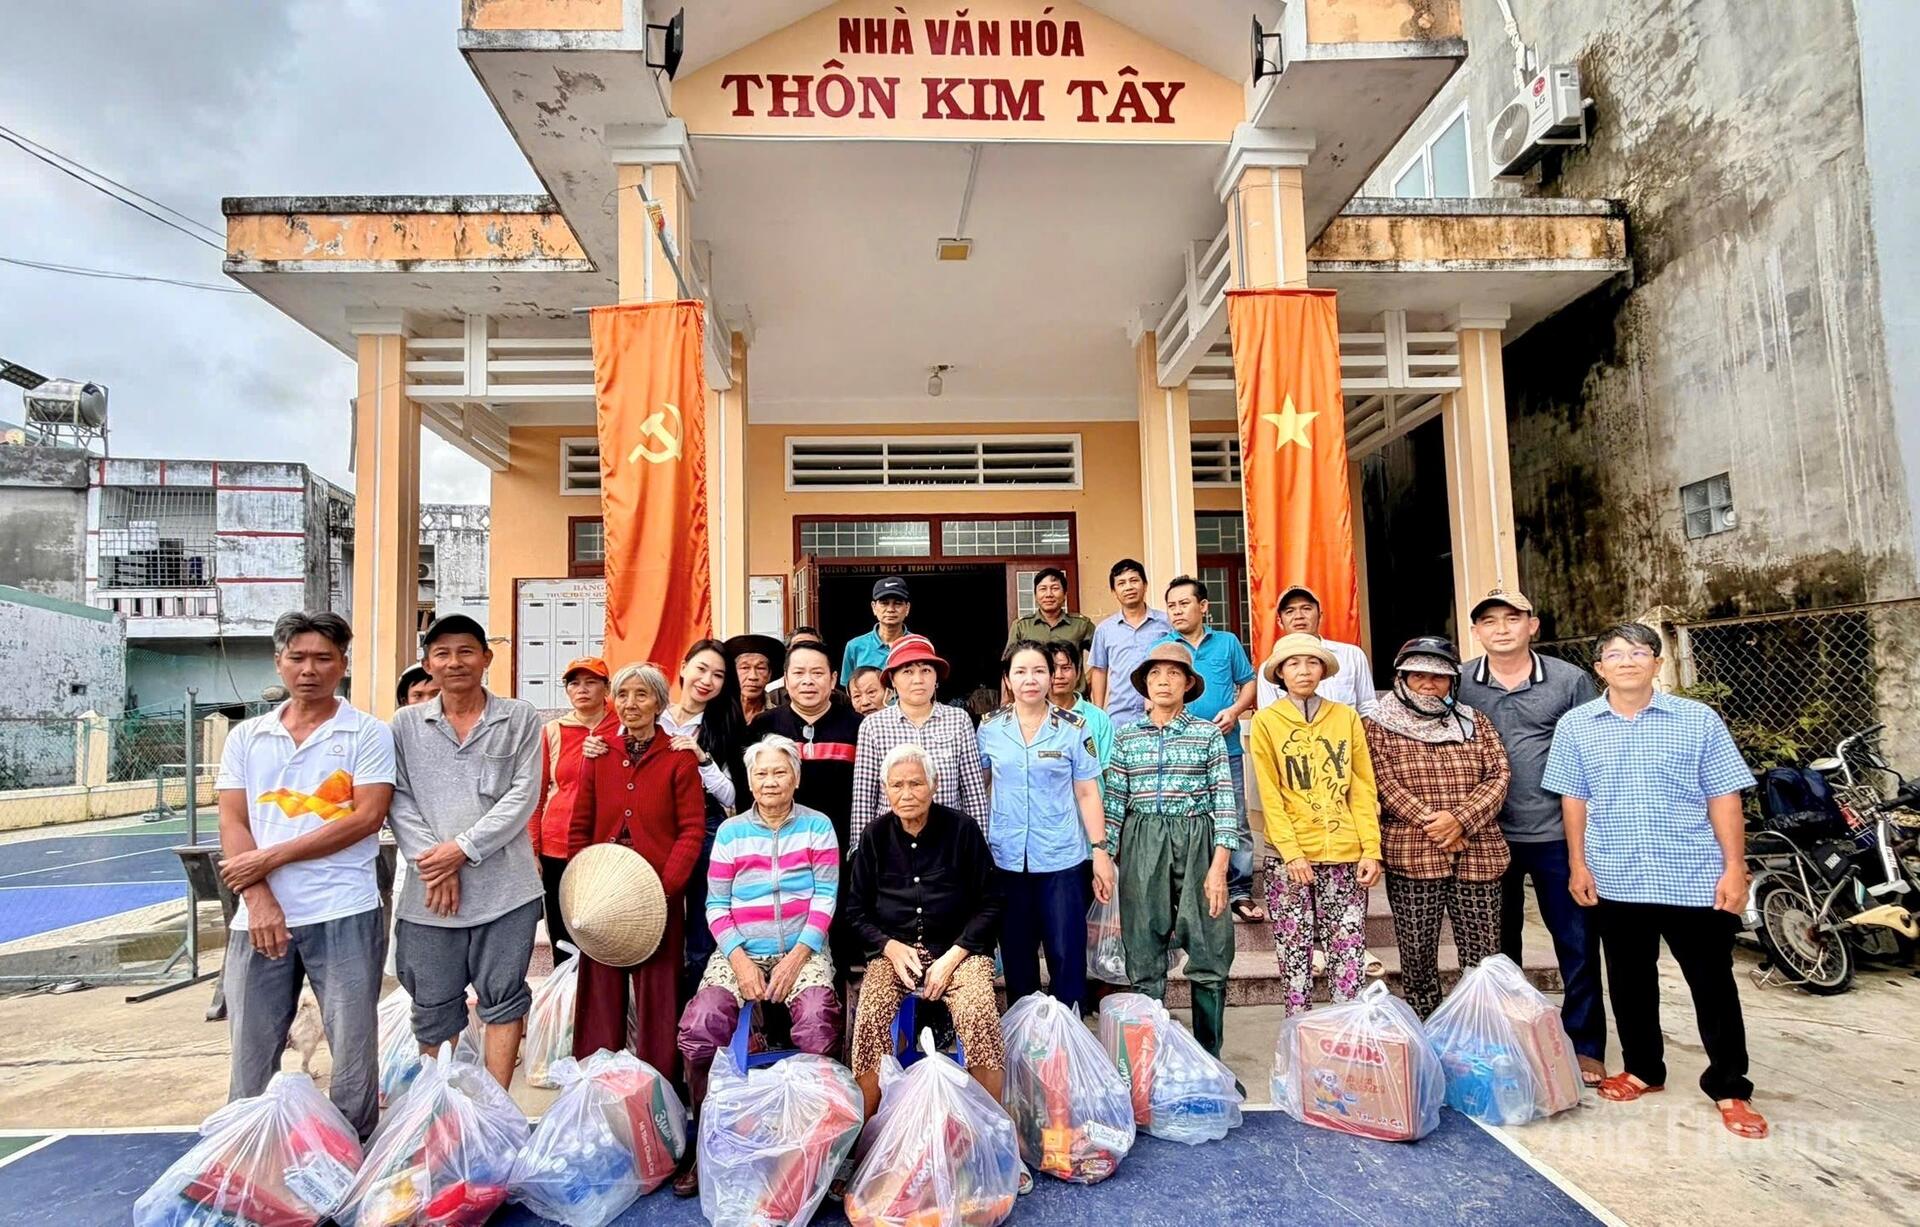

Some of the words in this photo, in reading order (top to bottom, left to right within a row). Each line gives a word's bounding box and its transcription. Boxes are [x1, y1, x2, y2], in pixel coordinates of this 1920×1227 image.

[838, 6, 914, 55] NHÀ
[924, 8, 1001, 56] VĂN
[1010, 6, 1085, 57] HÓA
[720, 58, 901, 119] THÔN
[921, 77, 1045, 122] KIM
[1066, 65, 1186, 124] TÂY
[1534, 94, 1546, 109] LG
